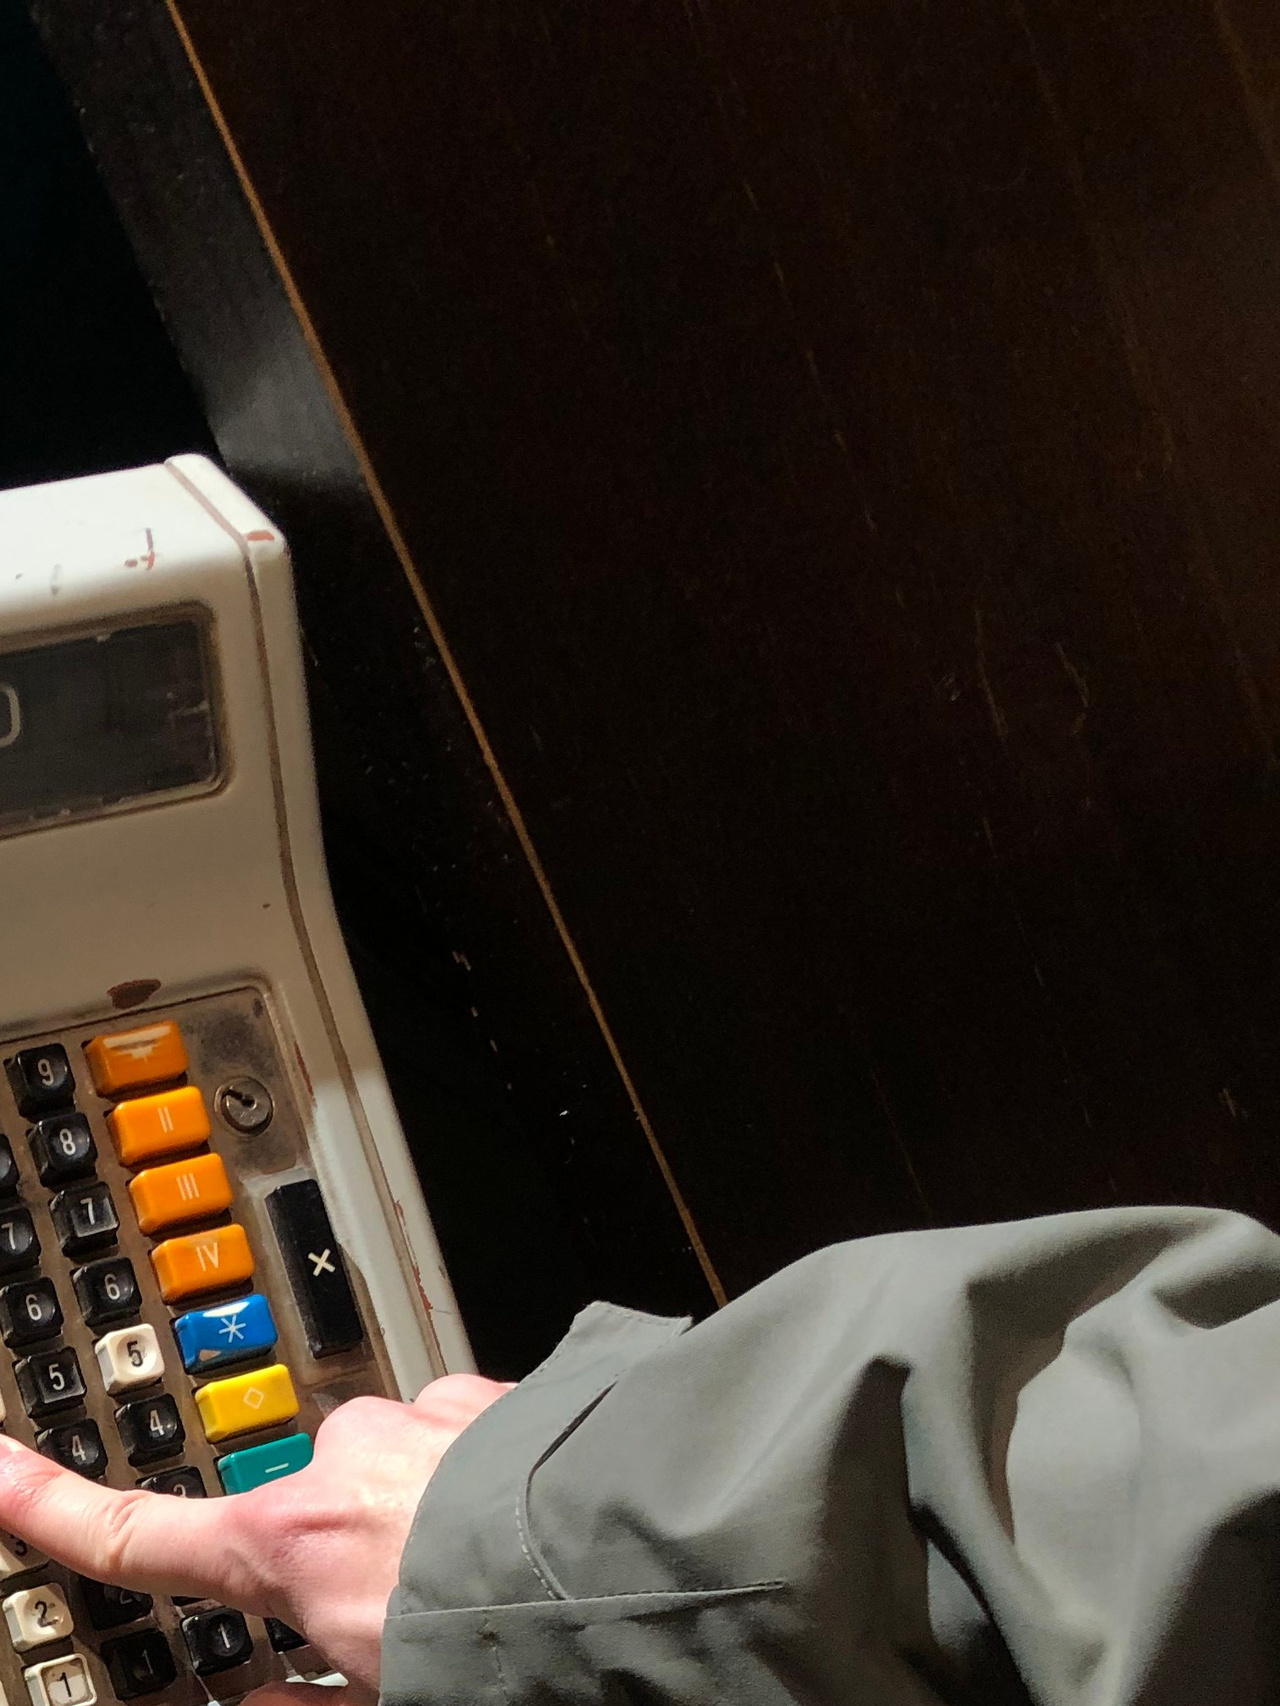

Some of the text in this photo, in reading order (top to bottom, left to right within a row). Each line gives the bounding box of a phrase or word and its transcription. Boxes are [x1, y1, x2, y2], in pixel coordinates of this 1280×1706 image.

[37, 1059, 54, 1086] 9
[59, 1128, 76, 1155] 8
[80, 1198, 96, 1225] 7
[1, 1223, 16, 1250] 7
[105, 1274, 120, 1300] 6
[25, 1294, 42, 1321] 6
[127, 1340, 143, 1368] 5
[48, 1364, 64, 1390] 5
[150, 1409, 165, 1436] 4
[71, 1434, 87, 1461] 4
[35, 1600, 58, 1628] 2
[217, 1622, 231, 1649] 1
[141, 1649, 154, 1675] 1
[59, 1672, 72, 1697] 1
